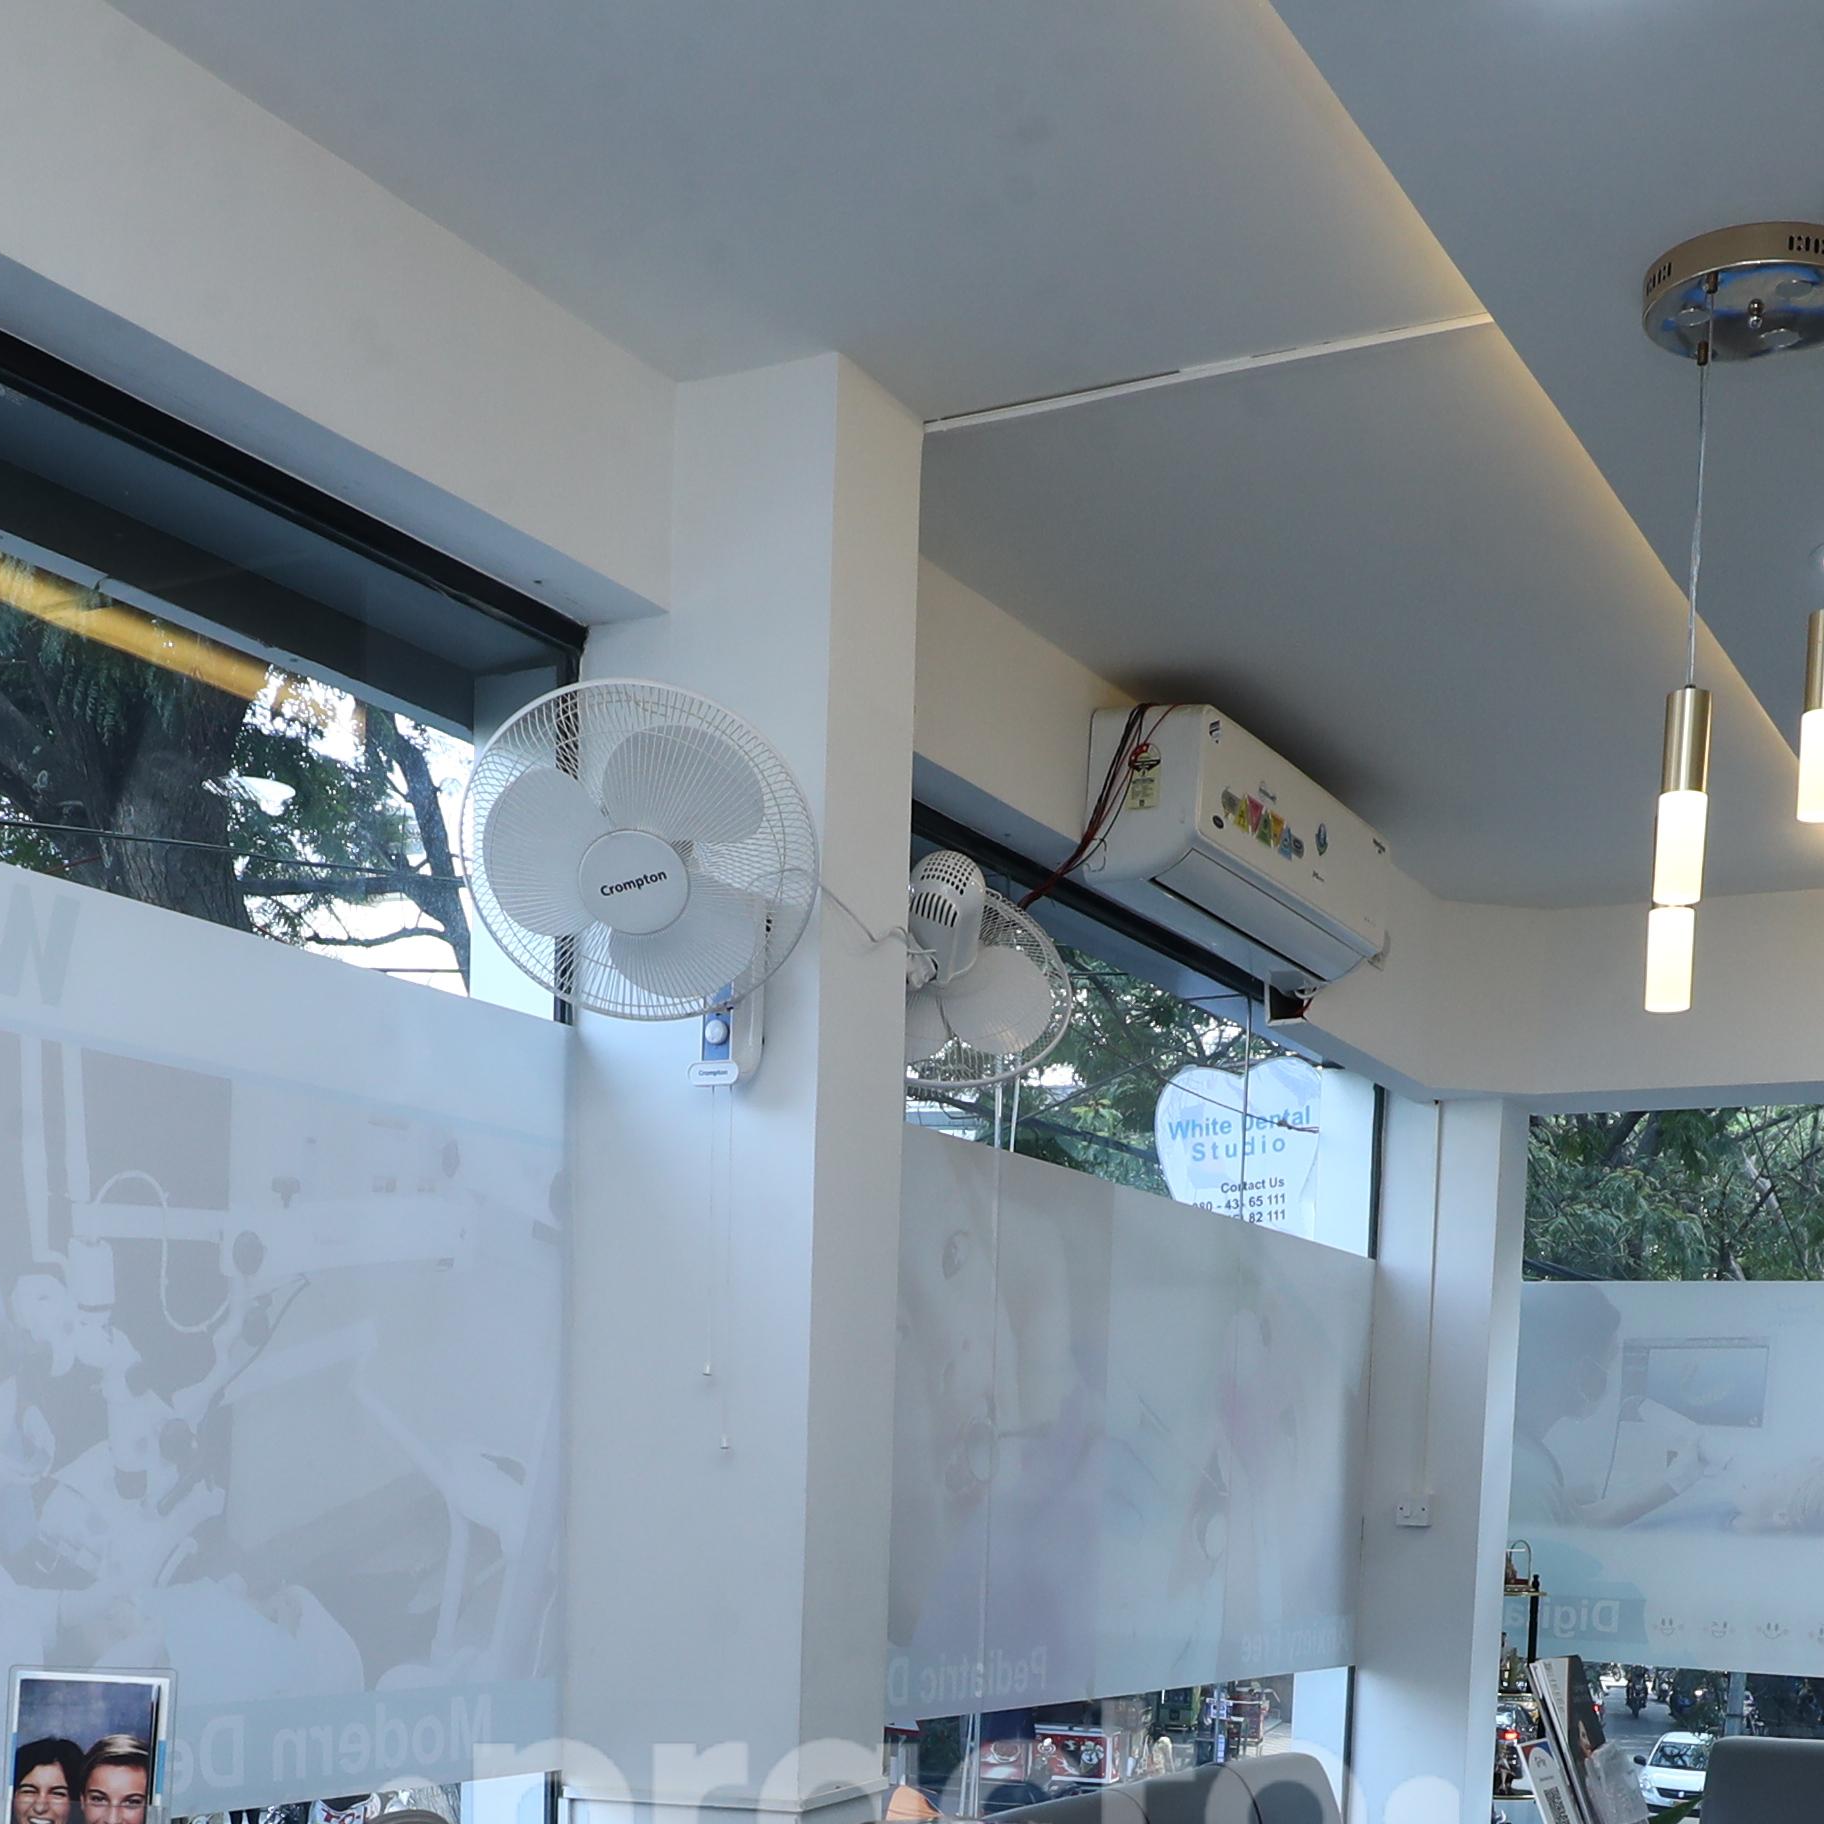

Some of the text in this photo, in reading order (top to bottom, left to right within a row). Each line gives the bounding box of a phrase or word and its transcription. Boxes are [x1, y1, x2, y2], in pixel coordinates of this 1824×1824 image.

[599, 867, 669, 898] Crompton
[1168, 1116, 1232, 1141] White
[1192, 1134, 1286, 1162] Studio
[1269, 1176, 1285, 1188] Us
[1248, 1195, 1264, 1208] 65
